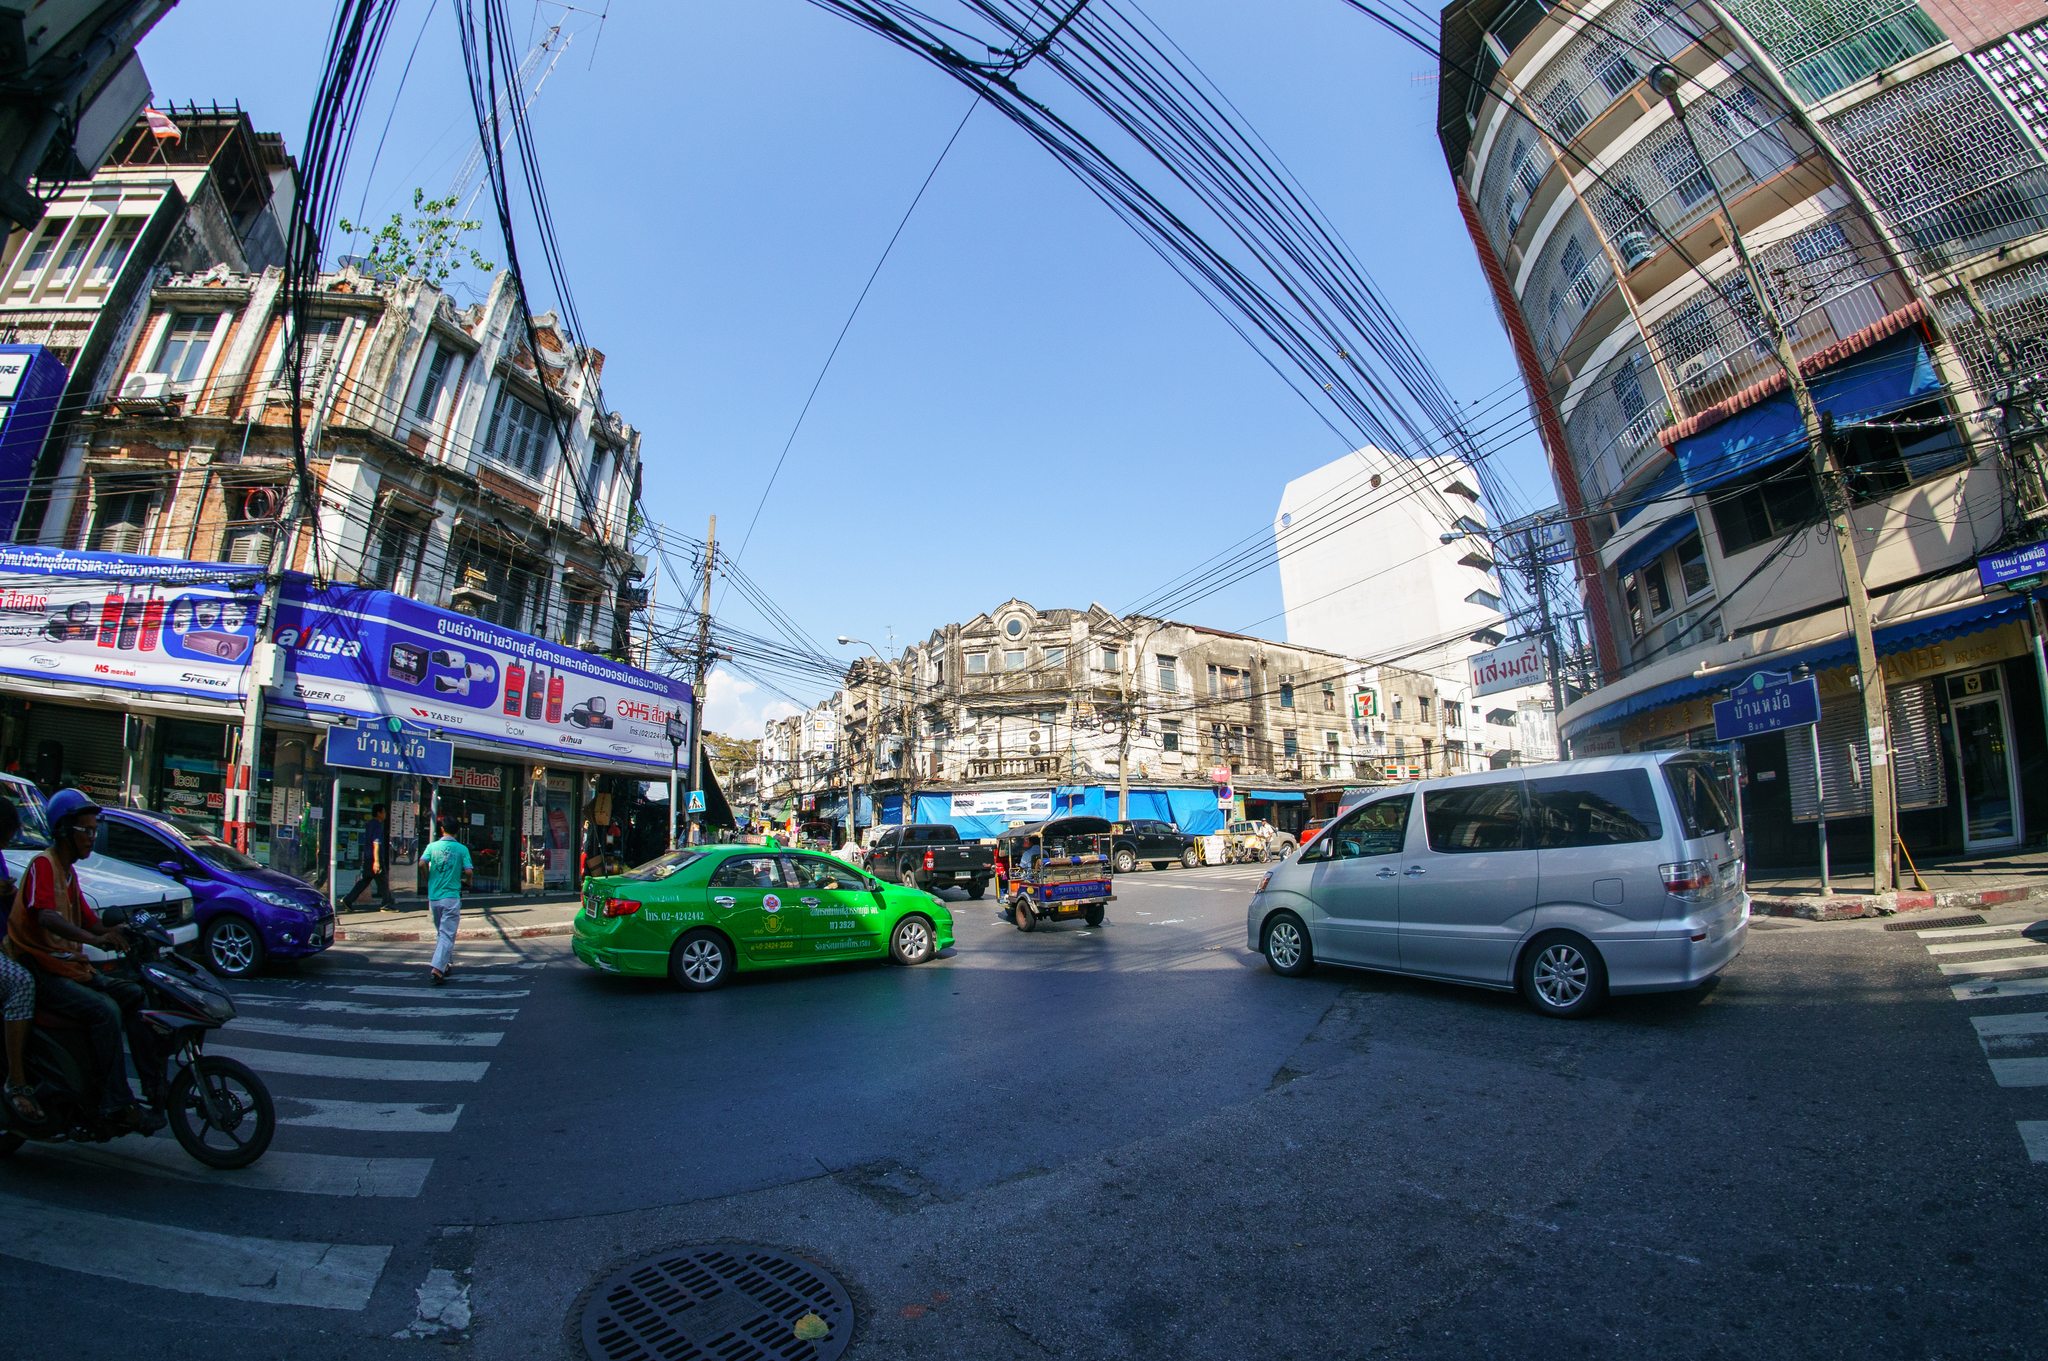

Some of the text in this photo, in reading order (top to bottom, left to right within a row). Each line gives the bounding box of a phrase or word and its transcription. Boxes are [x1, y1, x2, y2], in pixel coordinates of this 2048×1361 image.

[1991, 546, 2046, 570] ถนนบ้านหม้อ
[1996, 568, 2018, 578] Thanon
[295, 648, 332, 660] TECHNOLOGY
[95, 664, 109, 674] MS
[1879, 646, 1947, 681] ANEE
[1734, 688, 1791, 719] บ้านหม้อ
[430, 711, 463, 724] YAESU
[1748, 718, 1781, 731] Ban Mo
[357, 731, 426, 759] บ้านหม้อ
[371, 757, 411, 770] Ban Mo
[466, 767, 500, 788] สื่อสาร
[208, 793, 223, 804] MS
